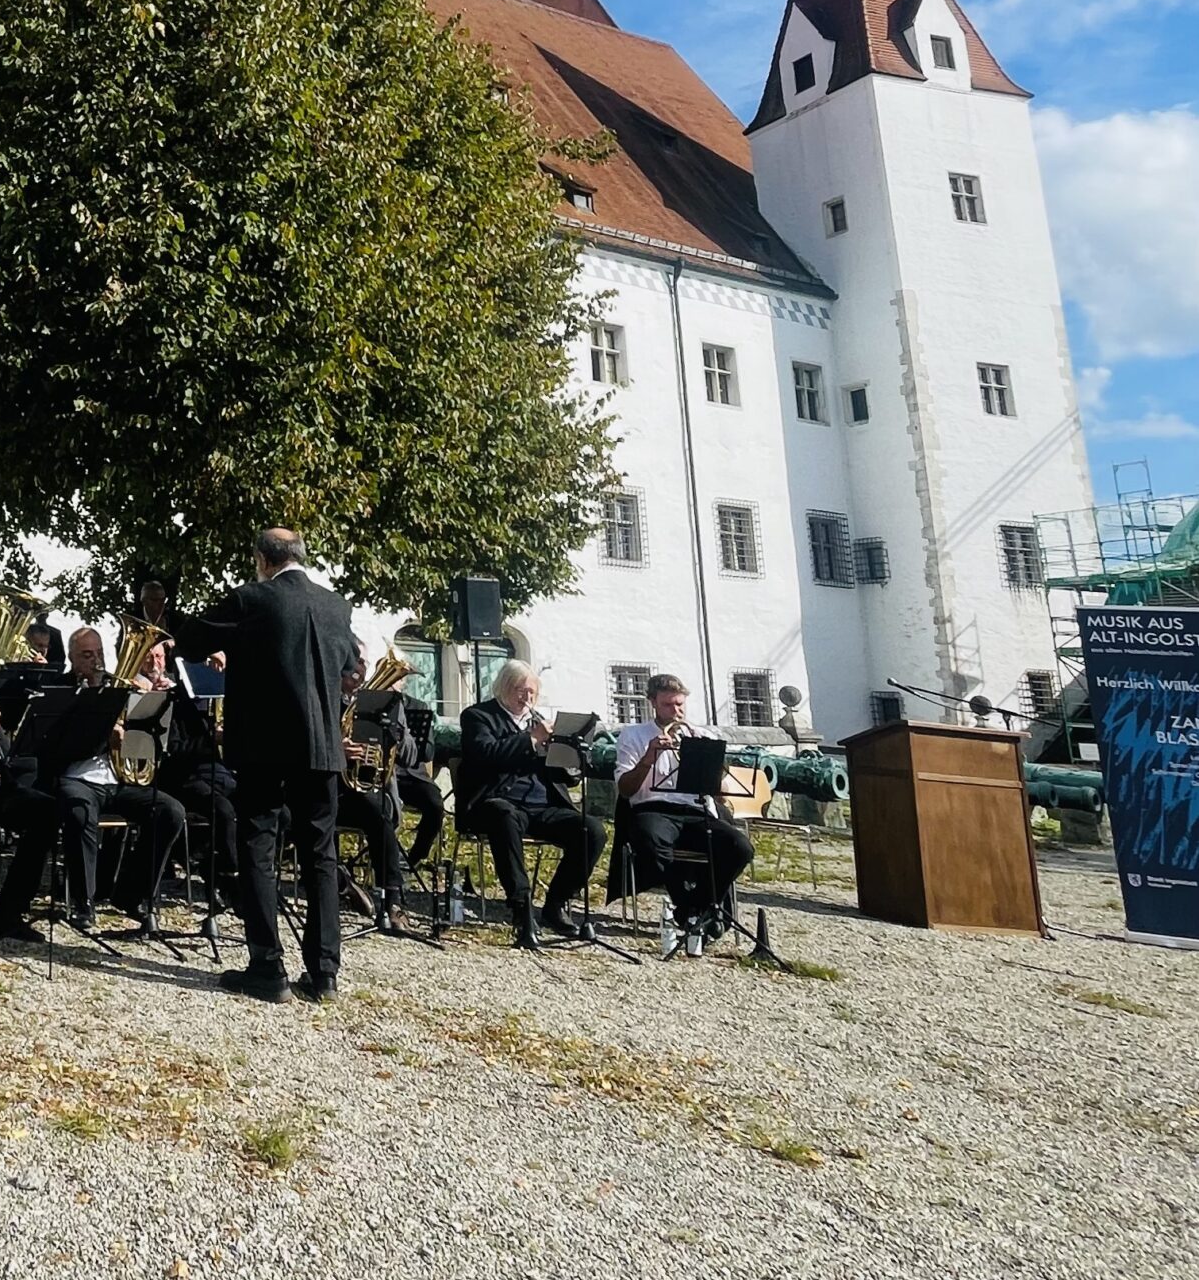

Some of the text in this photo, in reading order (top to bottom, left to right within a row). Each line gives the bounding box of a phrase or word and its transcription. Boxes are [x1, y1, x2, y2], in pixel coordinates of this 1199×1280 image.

[1087, 616, 1184, 630] MUSIK AUS
[1096, 676, 1155, 690] Herzlich
